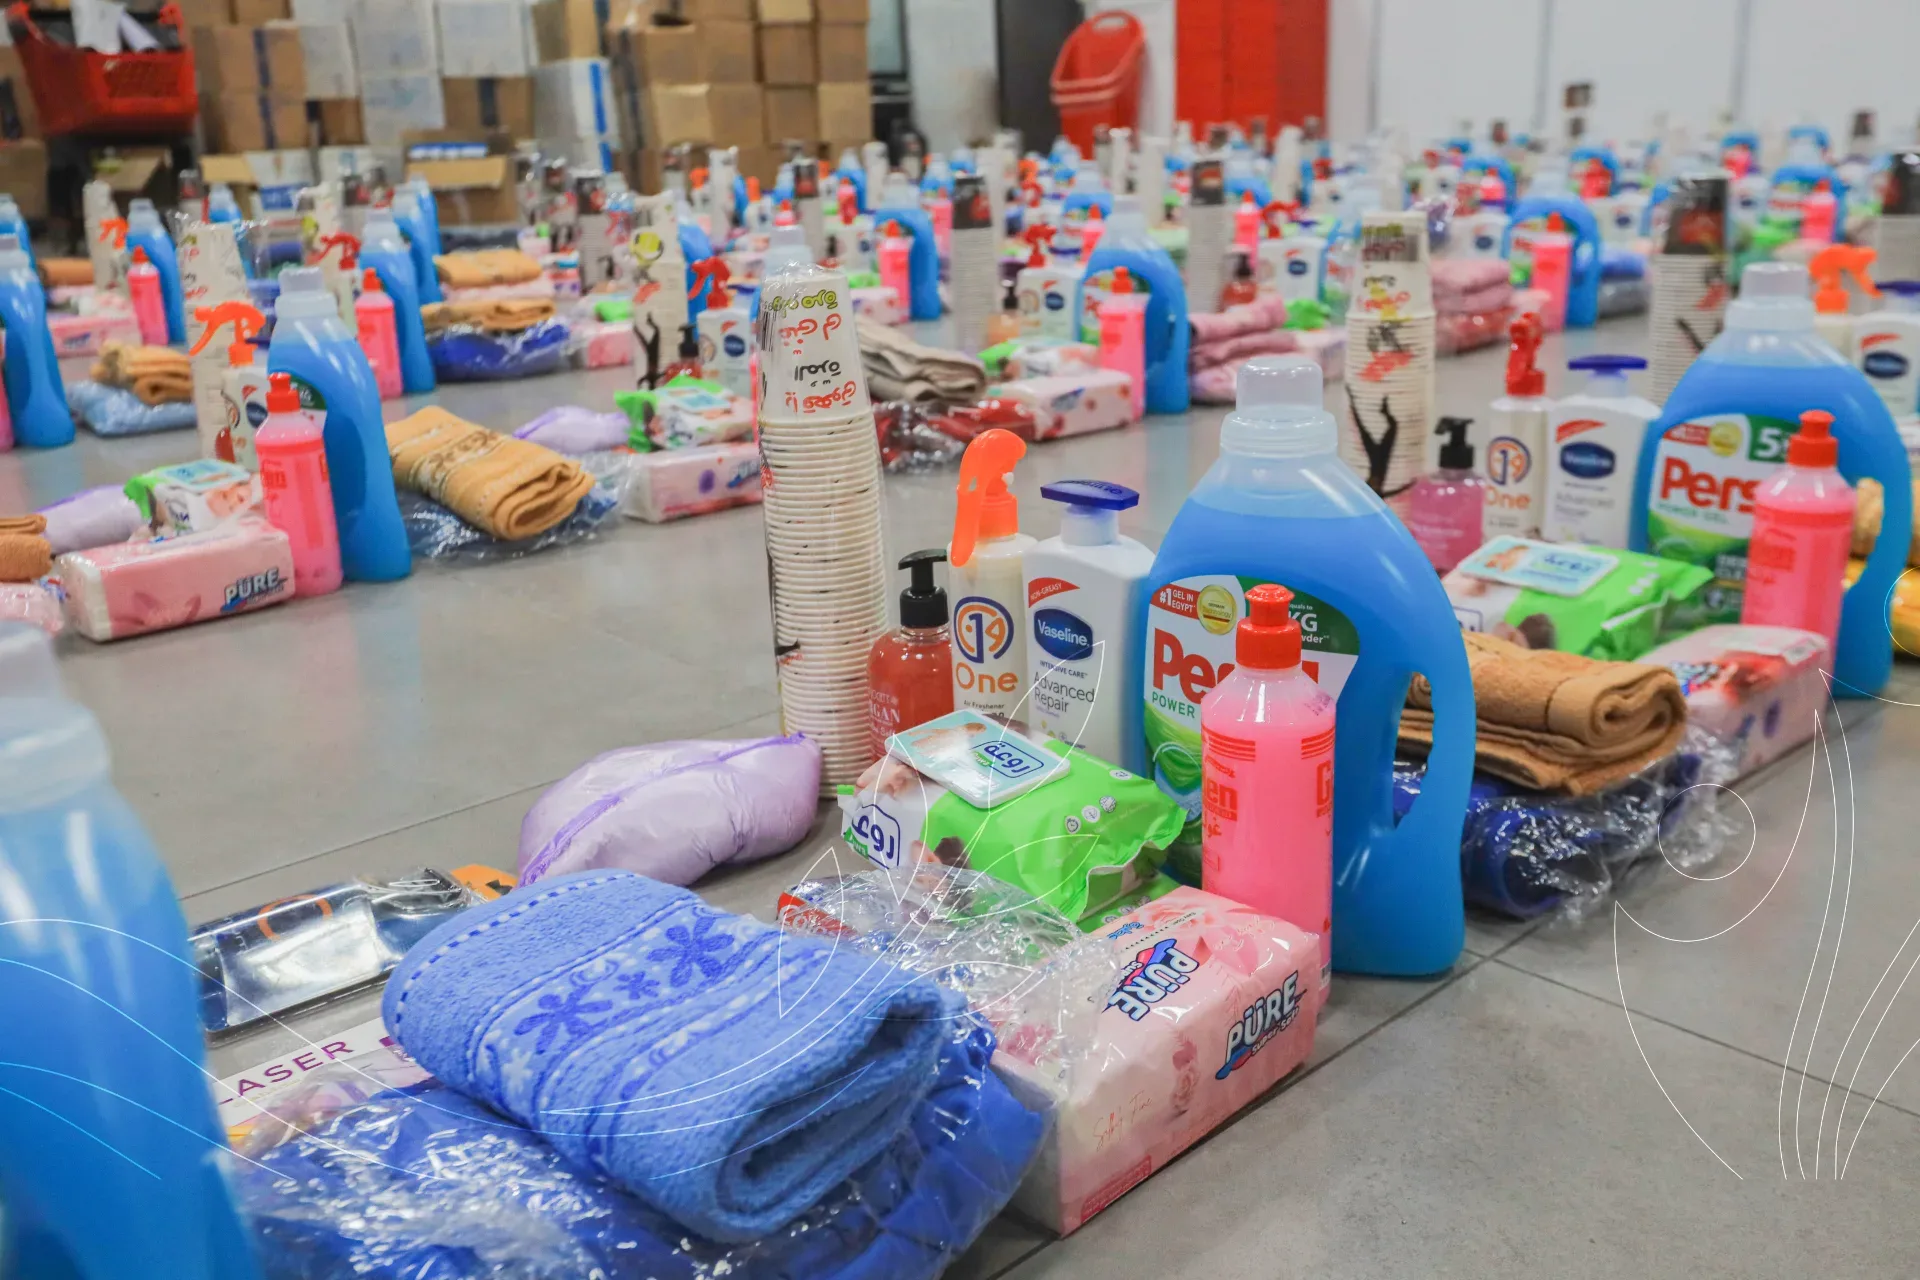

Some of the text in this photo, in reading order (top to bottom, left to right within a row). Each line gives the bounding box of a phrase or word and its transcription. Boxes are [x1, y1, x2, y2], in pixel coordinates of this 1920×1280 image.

[801, 289, 838, 309] مرة
[785, 391, 798, 413] يا
[1486, 485, 1530, 509] One
[1660, 456, 1760, 514] Pers
[1029, 582, 1062, 601] NON-GREASY
[1160, 587, 1172, 607] #1
[1172, 589, 1194, 602] GEL IN
[1037, 619, 1088, 647] Vaseline
[955, 662, 1019, 694] One
[1034, 671, 1095, 703] Advanced
[1034, 687, 1070, 713] Repair
[1152, 691, 1195, 719] POWER
[1206, 777, 1238, 811] en
[1110, 946, 1199, 1022] PÜRE
[1225, 969, 1299, 1062] PÜRE
